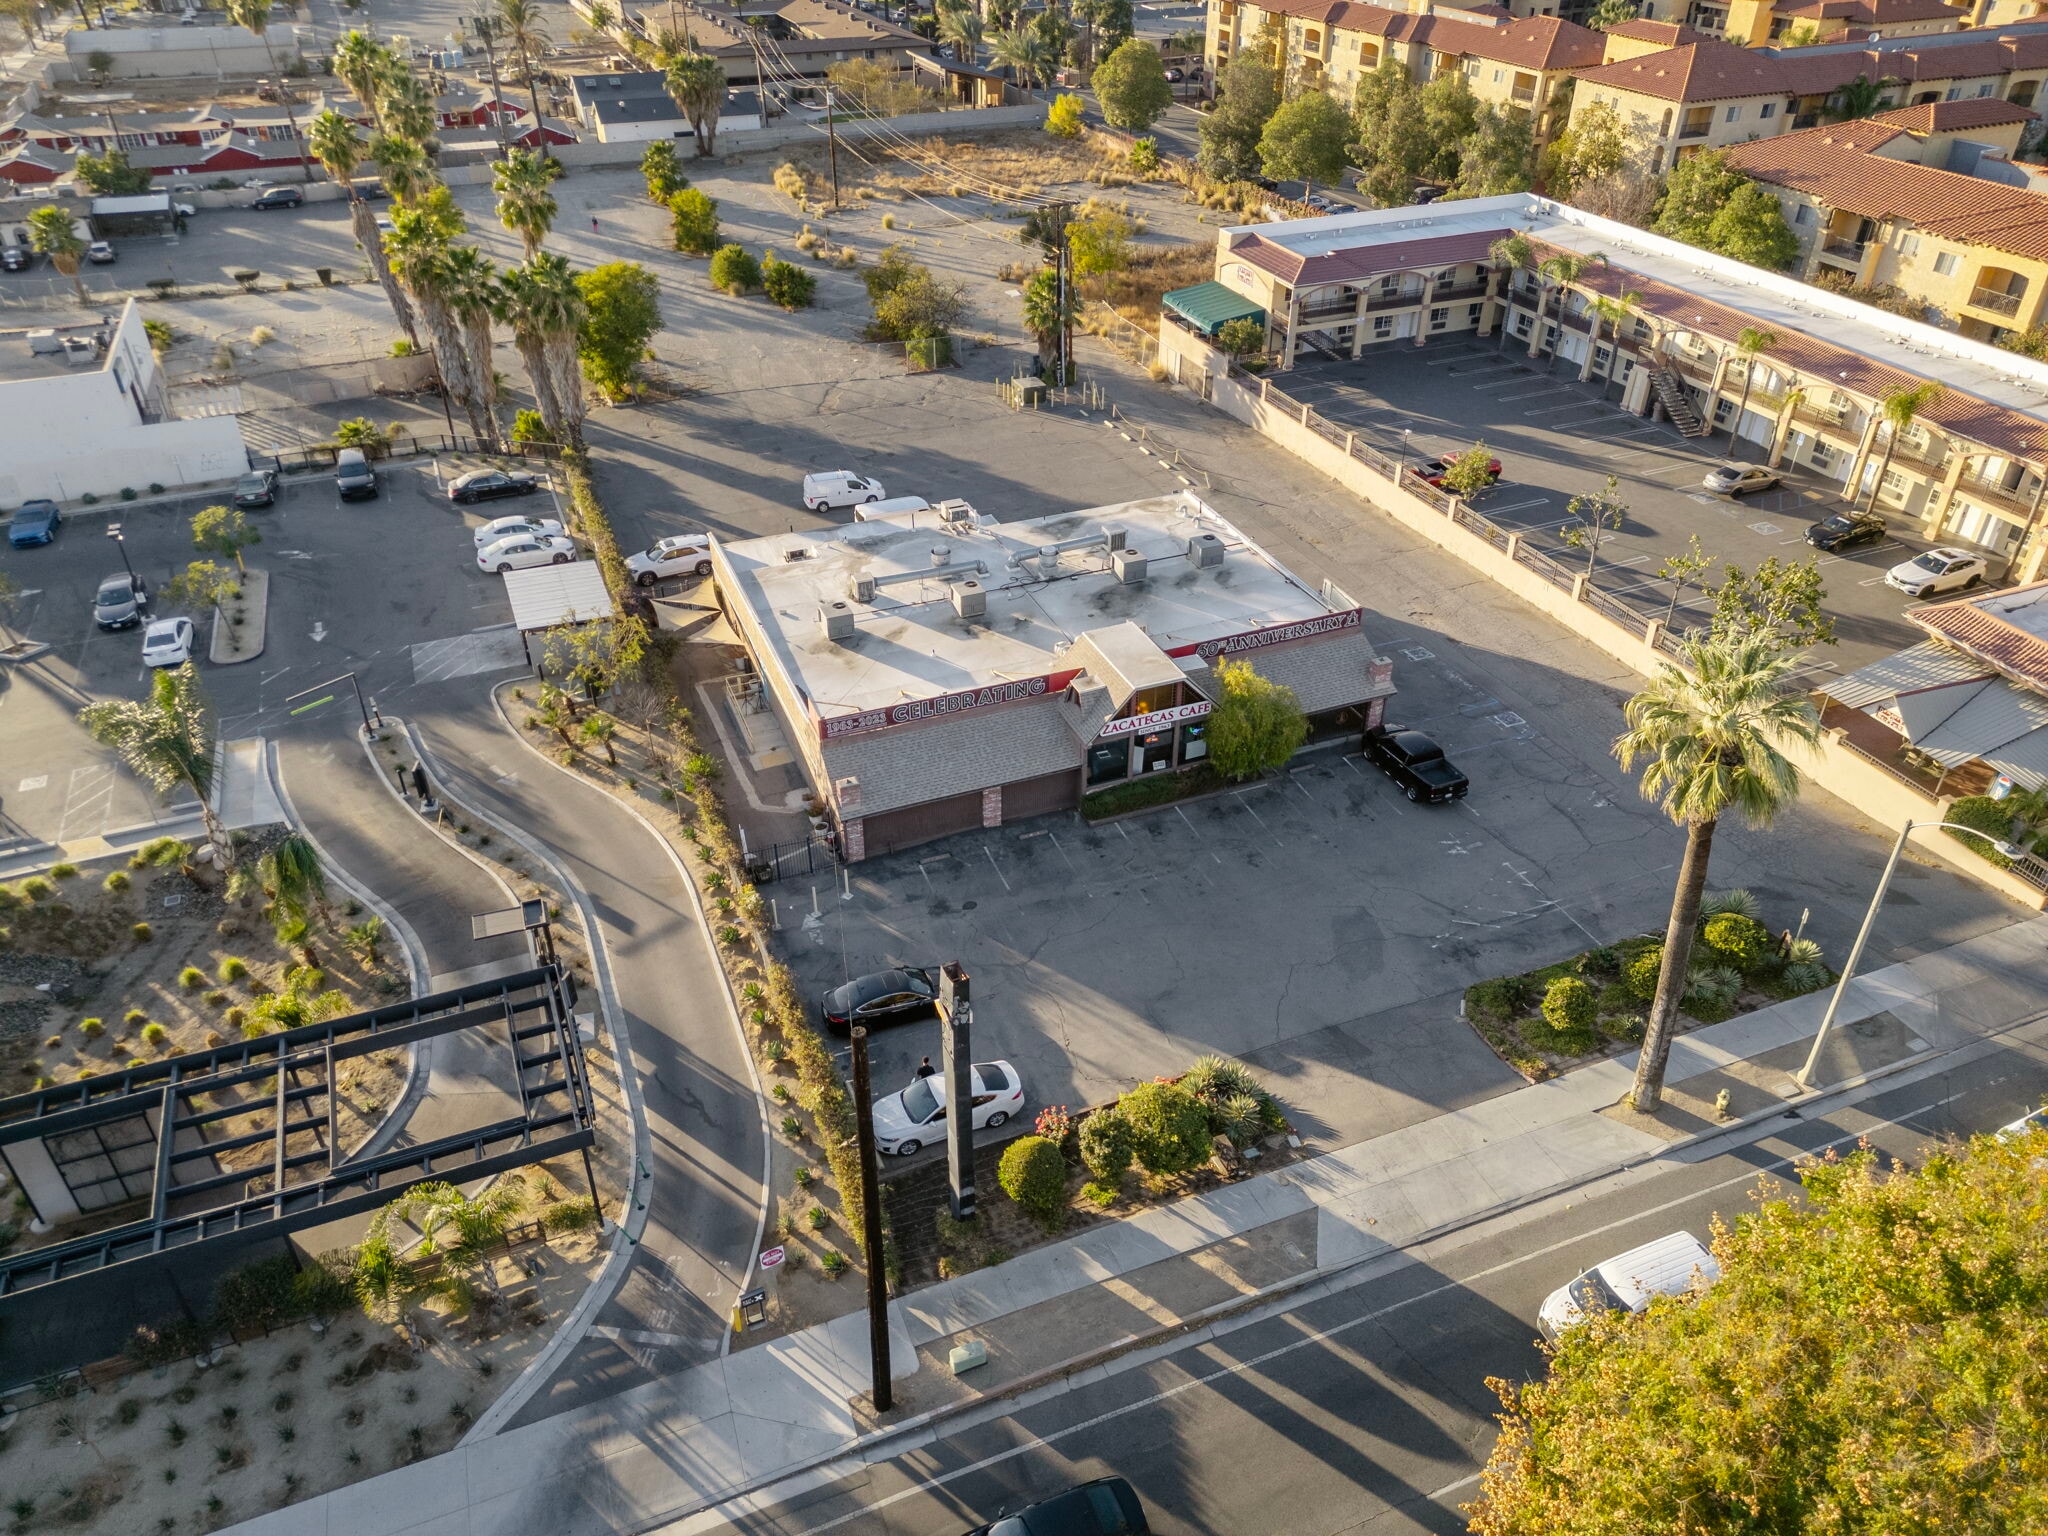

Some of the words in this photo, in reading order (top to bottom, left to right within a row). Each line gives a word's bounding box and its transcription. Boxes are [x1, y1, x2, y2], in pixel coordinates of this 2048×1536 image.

[1225, 614, 1346, 653] ANNIVERSARY
[826, 712, 887, 734] 1963-2023
[892, 678, 1047, 723] CELEBRATING
[1103, 710, 1174, 735] ZACATECAS
[1179, 702, 1211, 717] CAFE
[1139, 726, 1157, 734] SINCE
